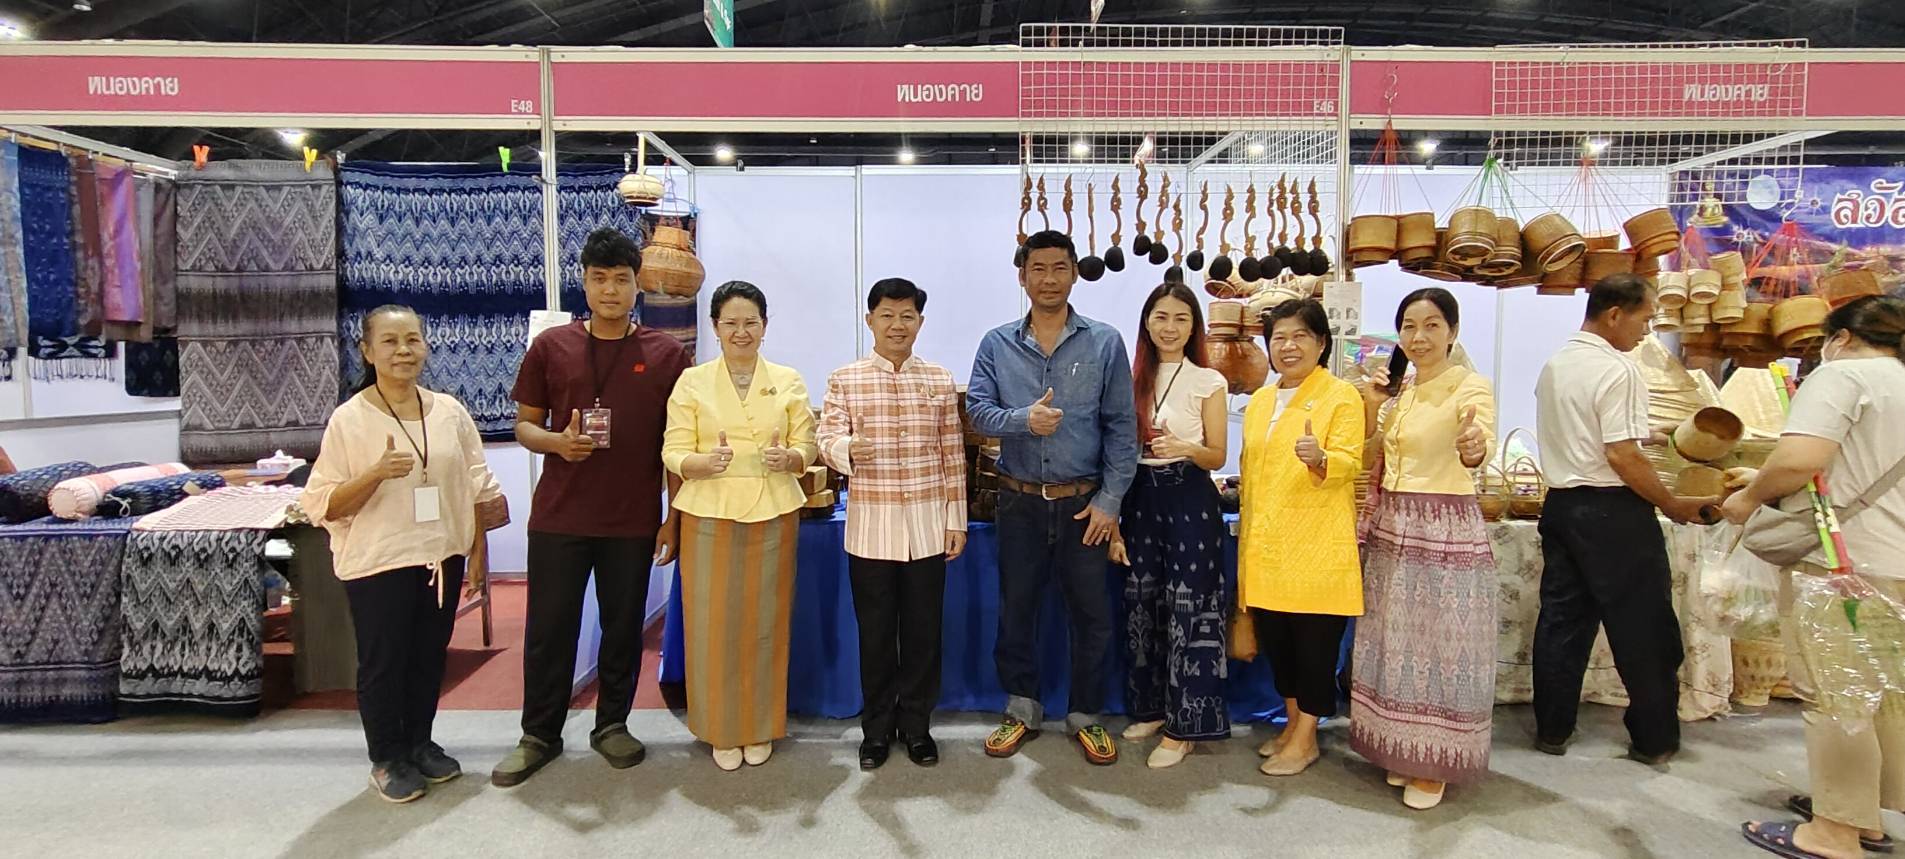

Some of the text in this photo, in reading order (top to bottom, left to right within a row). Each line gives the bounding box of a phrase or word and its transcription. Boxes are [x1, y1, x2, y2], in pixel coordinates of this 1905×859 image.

[87, 76, 179, 96] หนองคาย
[896, 83, 983, 103] หนองคาย
[1683, 83, 1770, 102] หนองคาย
[511, 99, 533, 113] E48
[1313, 100, 1335, 114] E46
